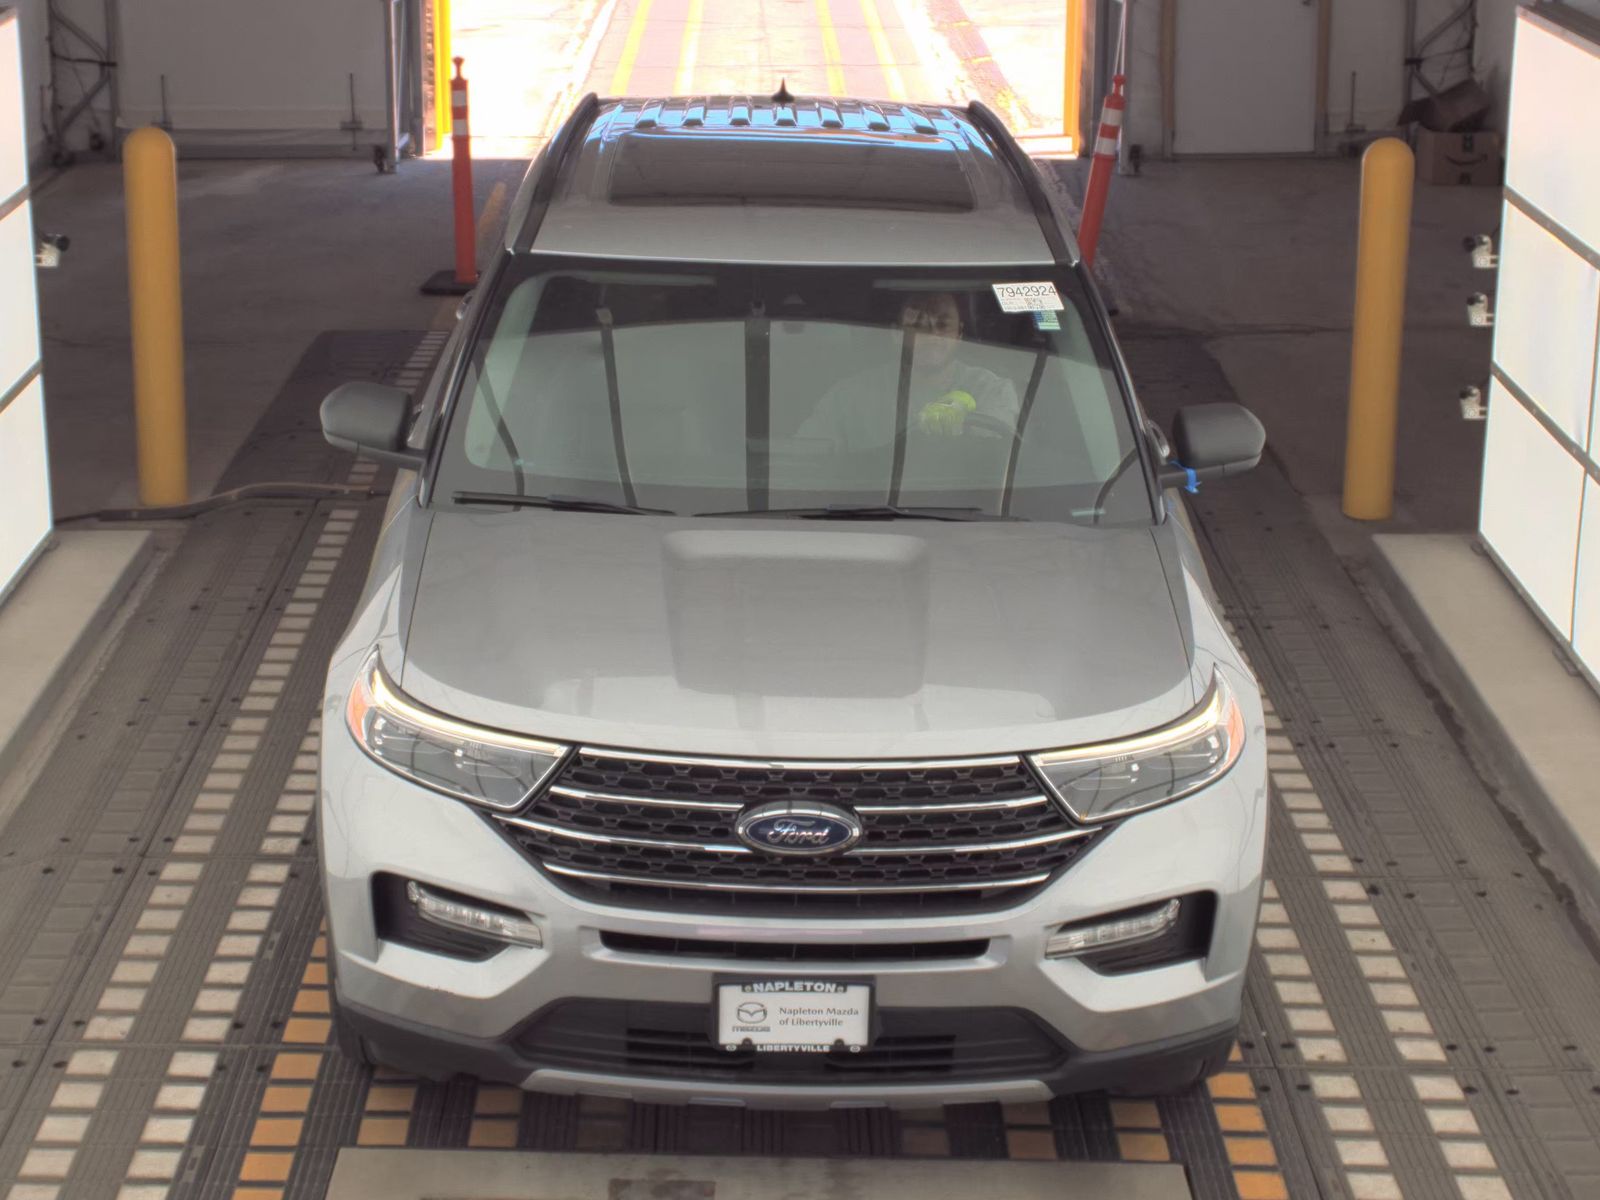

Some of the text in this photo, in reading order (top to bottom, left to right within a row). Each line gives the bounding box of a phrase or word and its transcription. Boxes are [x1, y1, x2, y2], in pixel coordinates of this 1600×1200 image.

[997, 286, 1056, 298] 7942924
[767, 818, 831, 844] Ford
[753, 981, 836, 993] NAPLETON
[779, 1007, 859, 1017] Napleton Mazda
[779, 1017, 844, 1028] of Libertyville
[756, 1044, 831, 1053] LIBERTYVILLE
